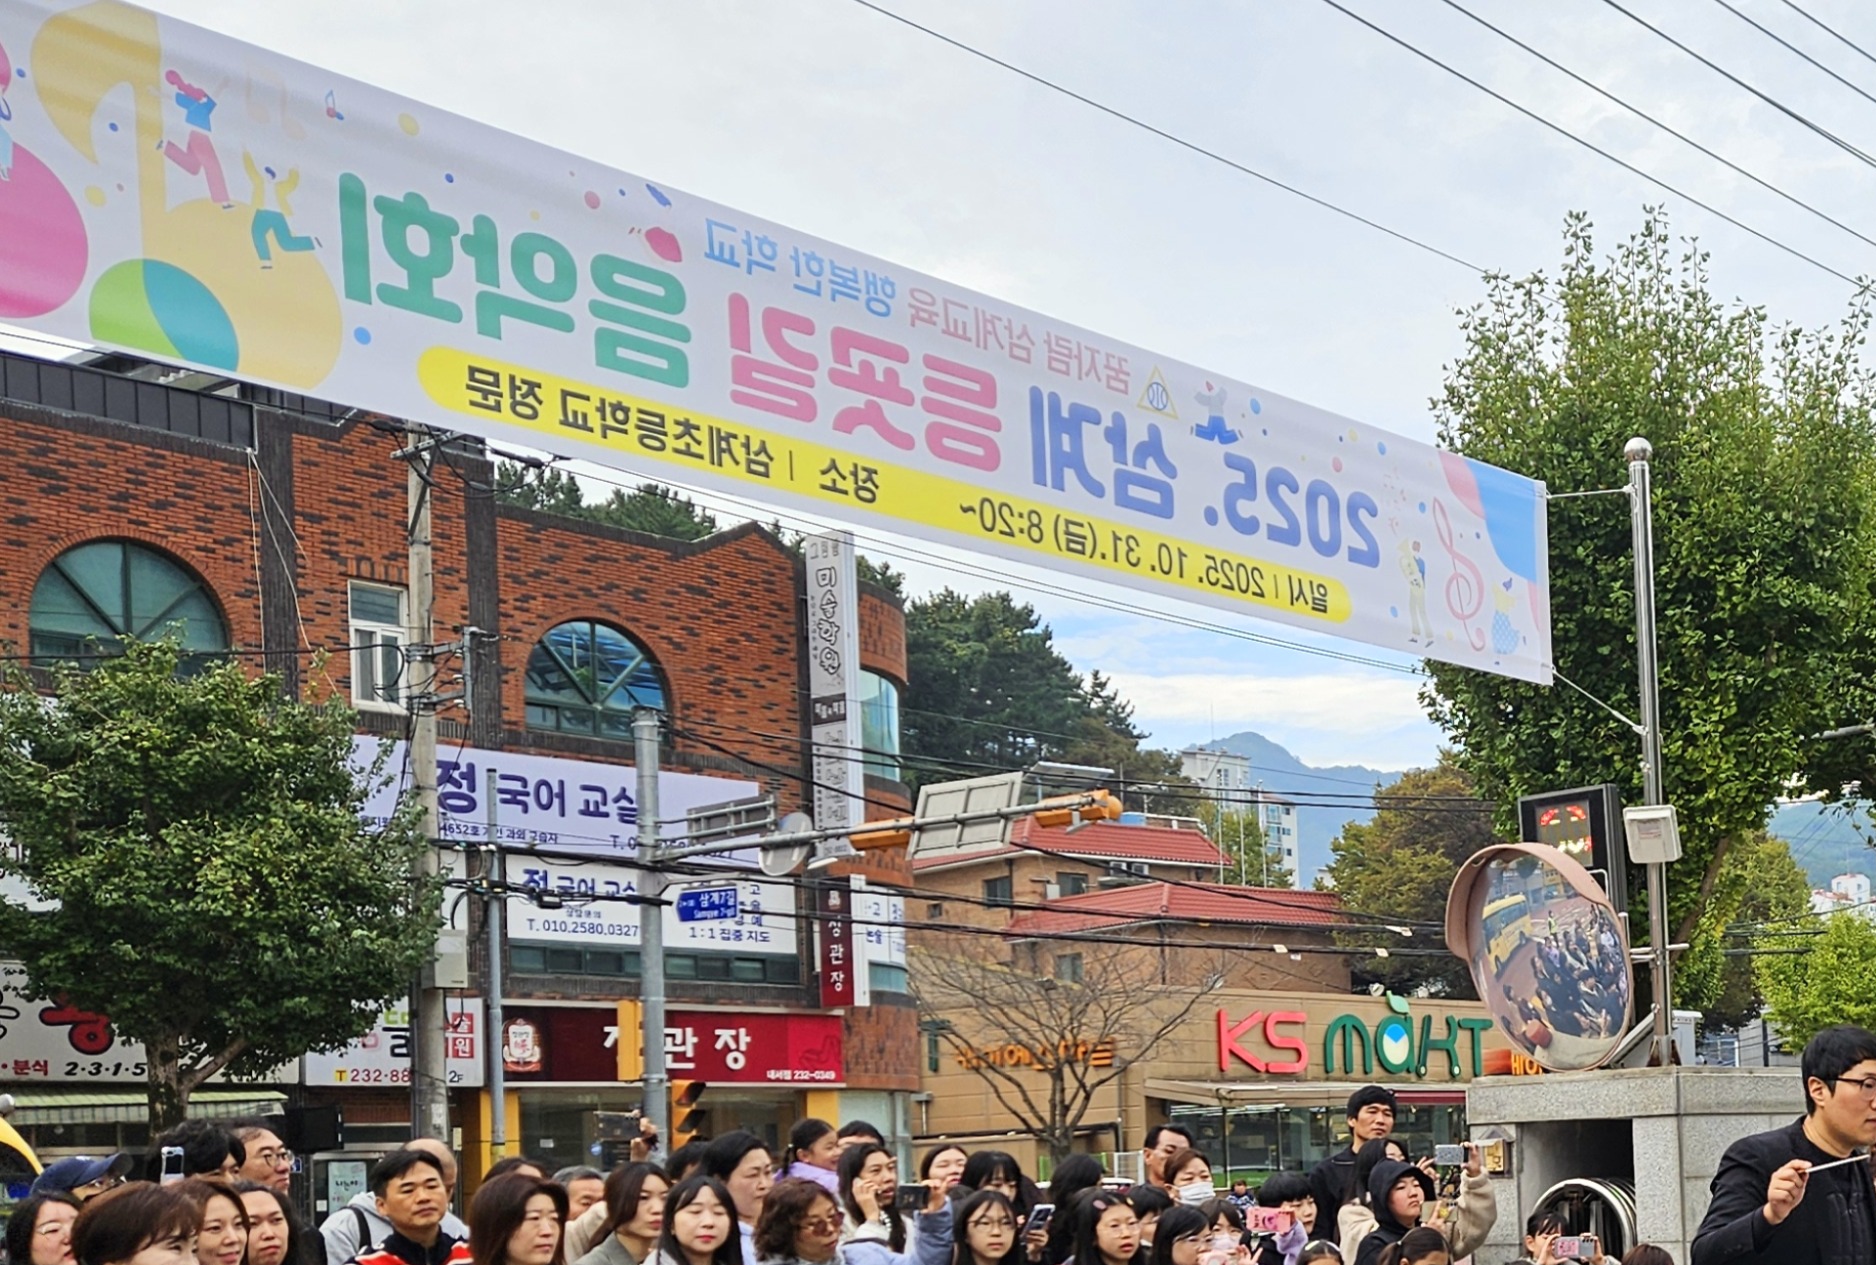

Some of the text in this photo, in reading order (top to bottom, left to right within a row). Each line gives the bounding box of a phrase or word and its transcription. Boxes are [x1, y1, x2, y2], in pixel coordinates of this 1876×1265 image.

[496, 773, 567, 818] 국어
[699, 890, 736, 908] 삼계7길
[541, 919, 639, 938] 010.2580.0327
[719, 928, 744, 942] 집중
[746, 930, 771, 943] 지도
[1216, 1008, 1309, 1075] KS
[12, 1059, 49, 1077] 분식
